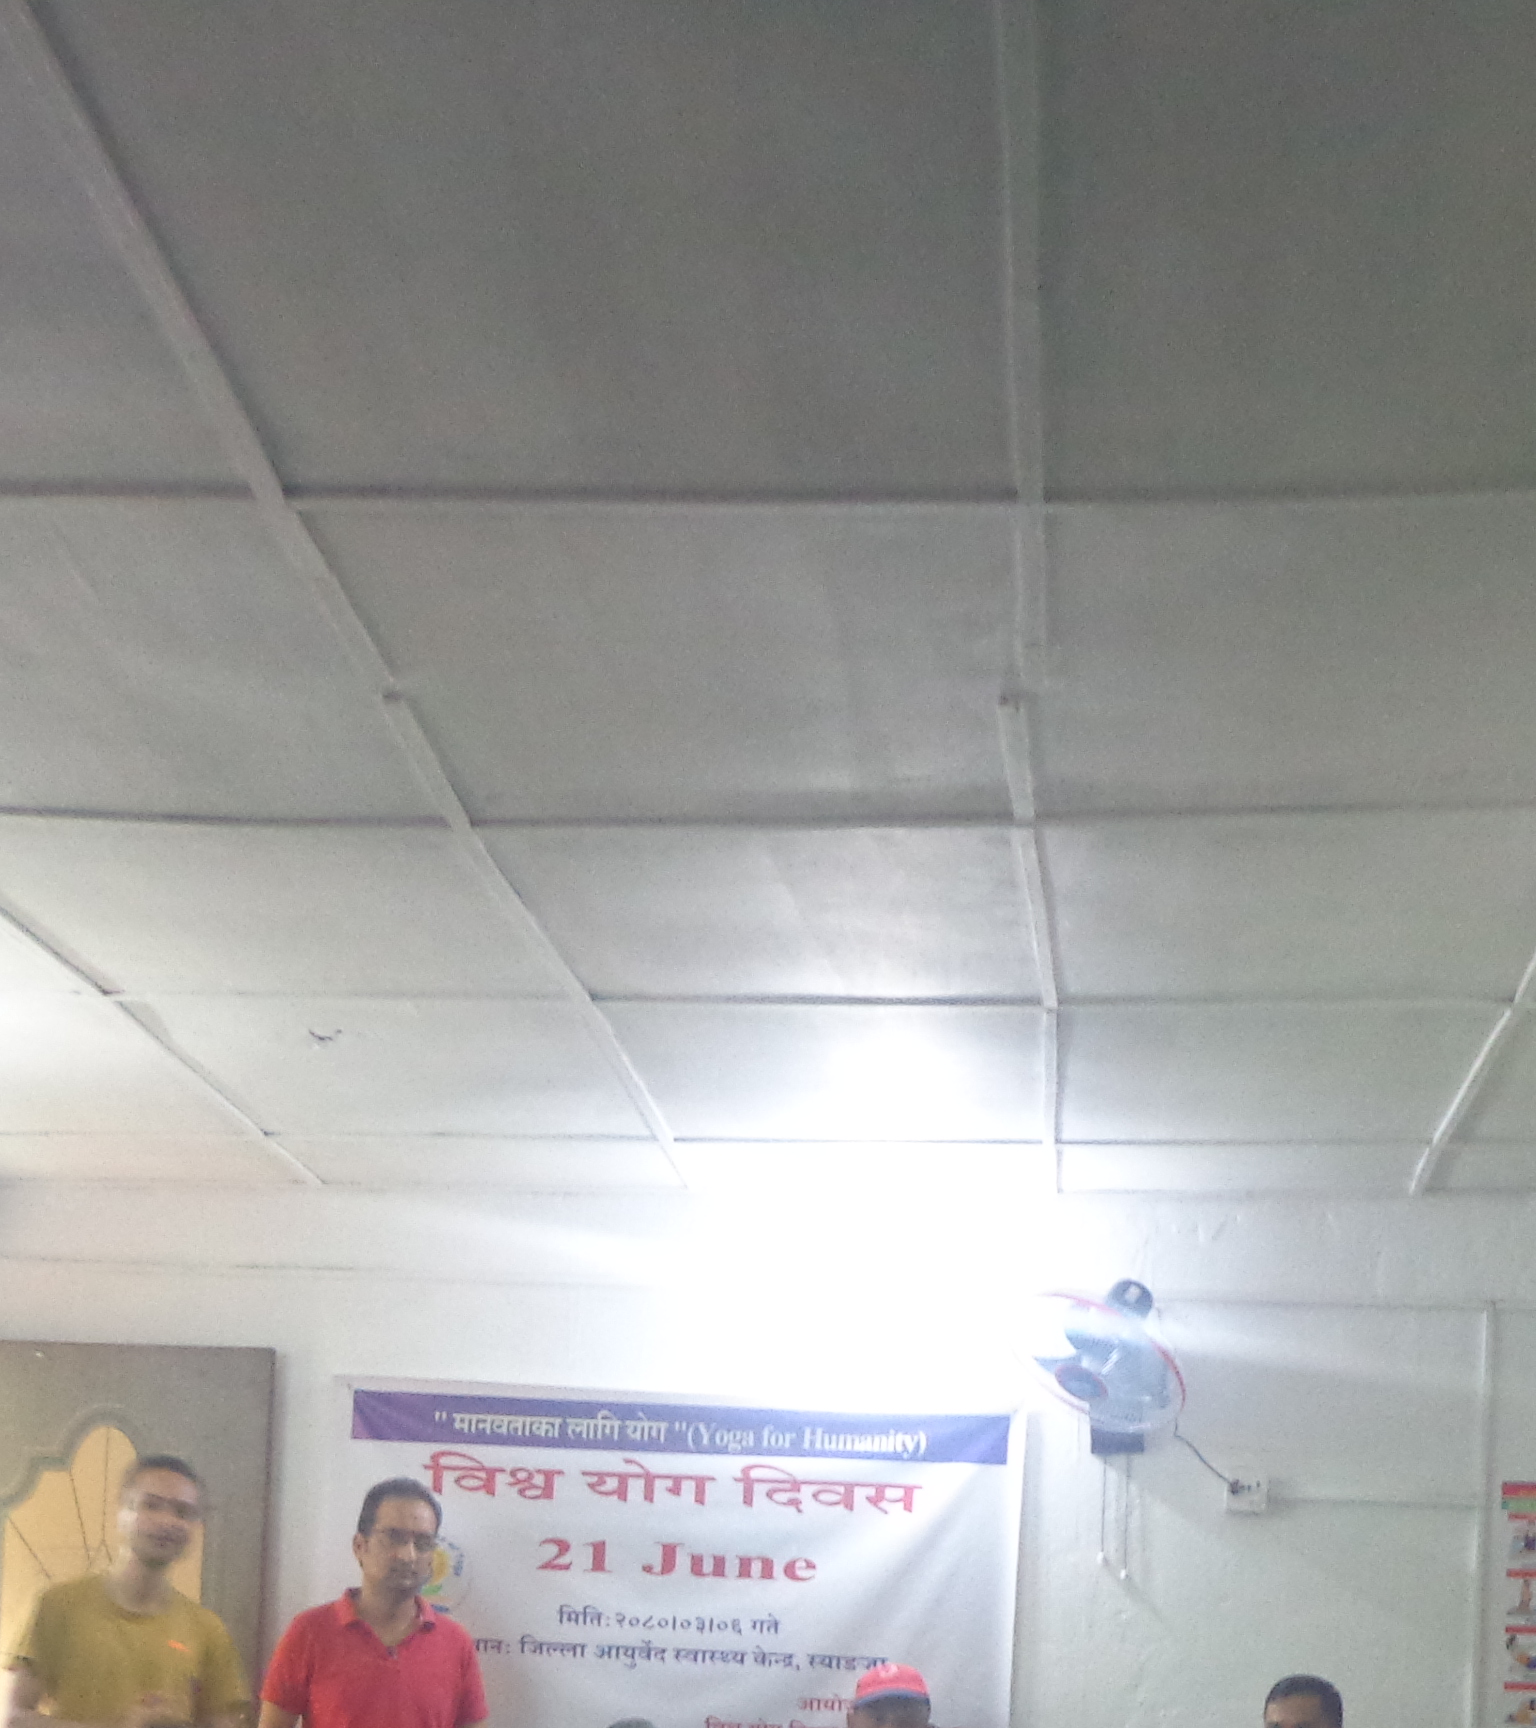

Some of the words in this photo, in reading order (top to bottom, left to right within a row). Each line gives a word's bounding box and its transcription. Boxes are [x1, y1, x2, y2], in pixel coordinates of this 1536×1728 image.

[452, 1412, 563, 1439] मानवताका
[565, 1409, 623, 1441] लागि
[625, 1411, 668, 1444] योग
[763, 1424, 795, 1449] for
[803, 1426, 927, 1459] Humanity)
[423, 1450, 565, 1501] विश्व
[581, 1458, 716, 1506] योग
[732, 1464, 923, 1515] दिवस
[536, 1537, 613, 1574] 21
[641, 1541, 818, 1582] June
[750, 1612, 781, 1635] गते
[519, 1633, 588, 1659] जिल्ला
[594, 1639, 668, 1670] आयुर्वेद
